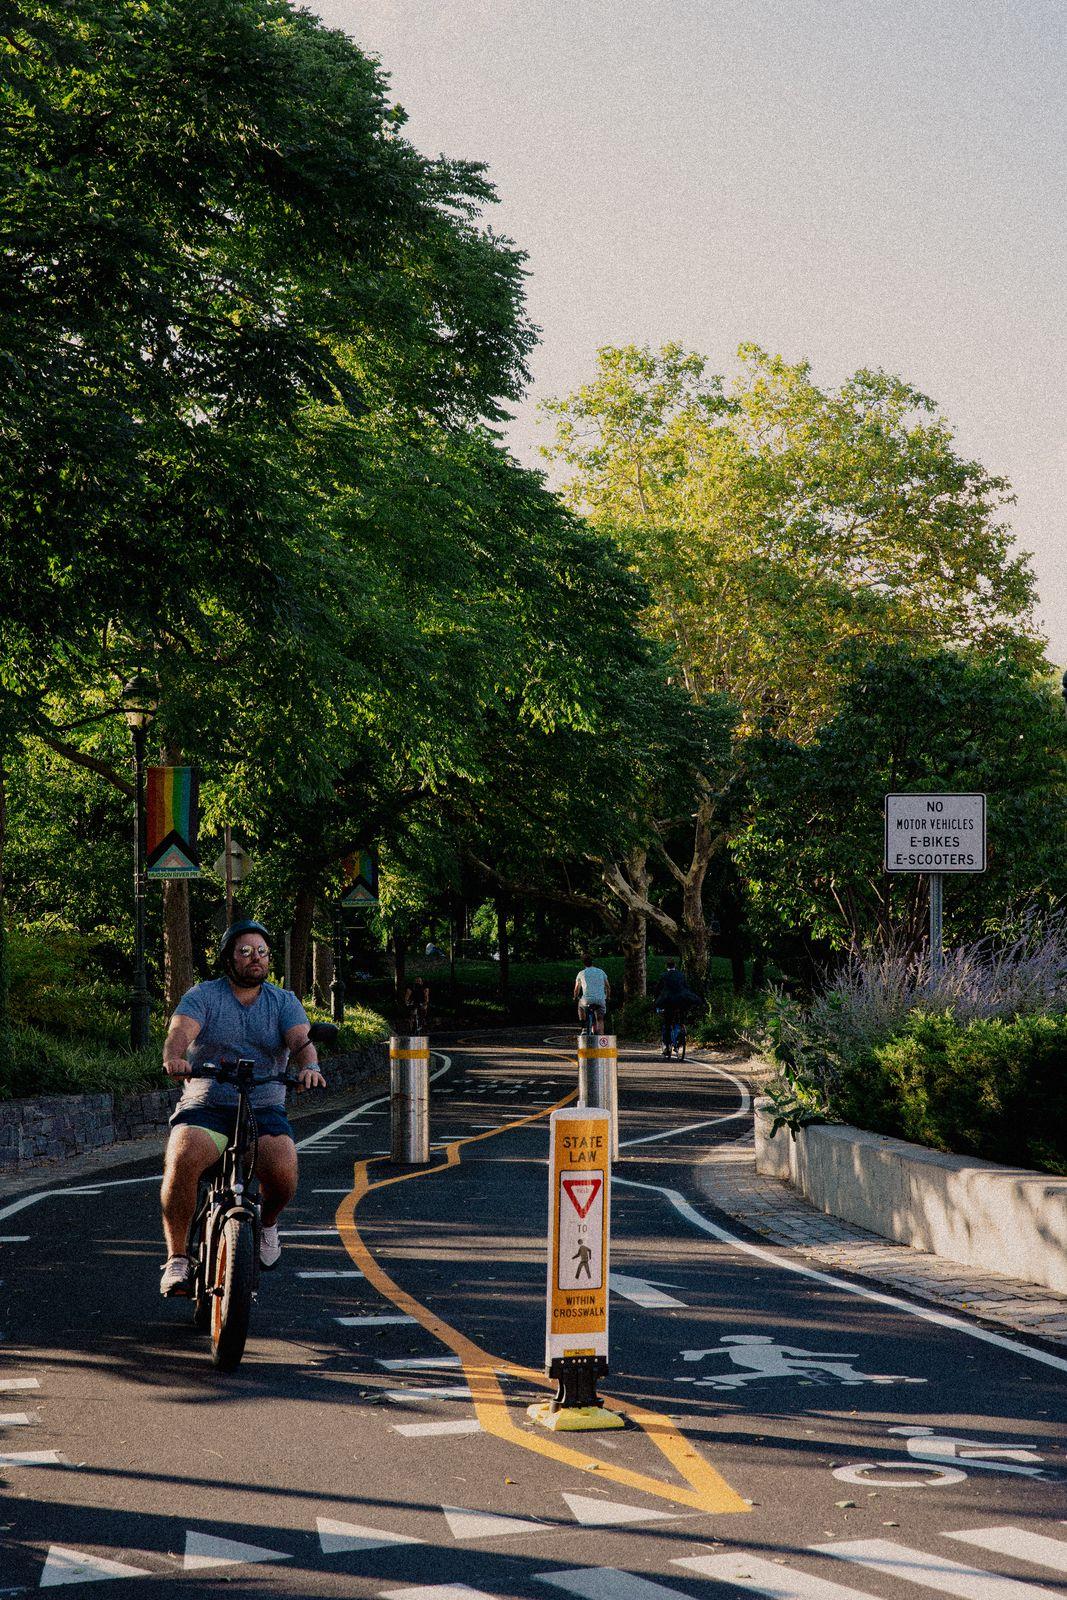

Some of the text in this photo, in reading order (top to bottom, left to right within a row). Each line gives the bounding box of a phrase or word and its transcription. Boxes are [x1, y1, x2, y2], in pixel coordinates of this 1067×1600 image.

[927, 802, 943, 812] NO
[896, 819, 974, 830] MOTOR VEHICLES
[910, 836, 960, 847] E-BIKES
[896, 854, 974, 865] E-SCOOTERS
[563, 1136, 602, 1148] STATE
[569, 1150, 597, 1163] LAW
[577, 1224, 588, 1233] TO
[566, 1296, 595, 1305] WITHIN
[553, 1307, 604, 1317] CROSSWALK
